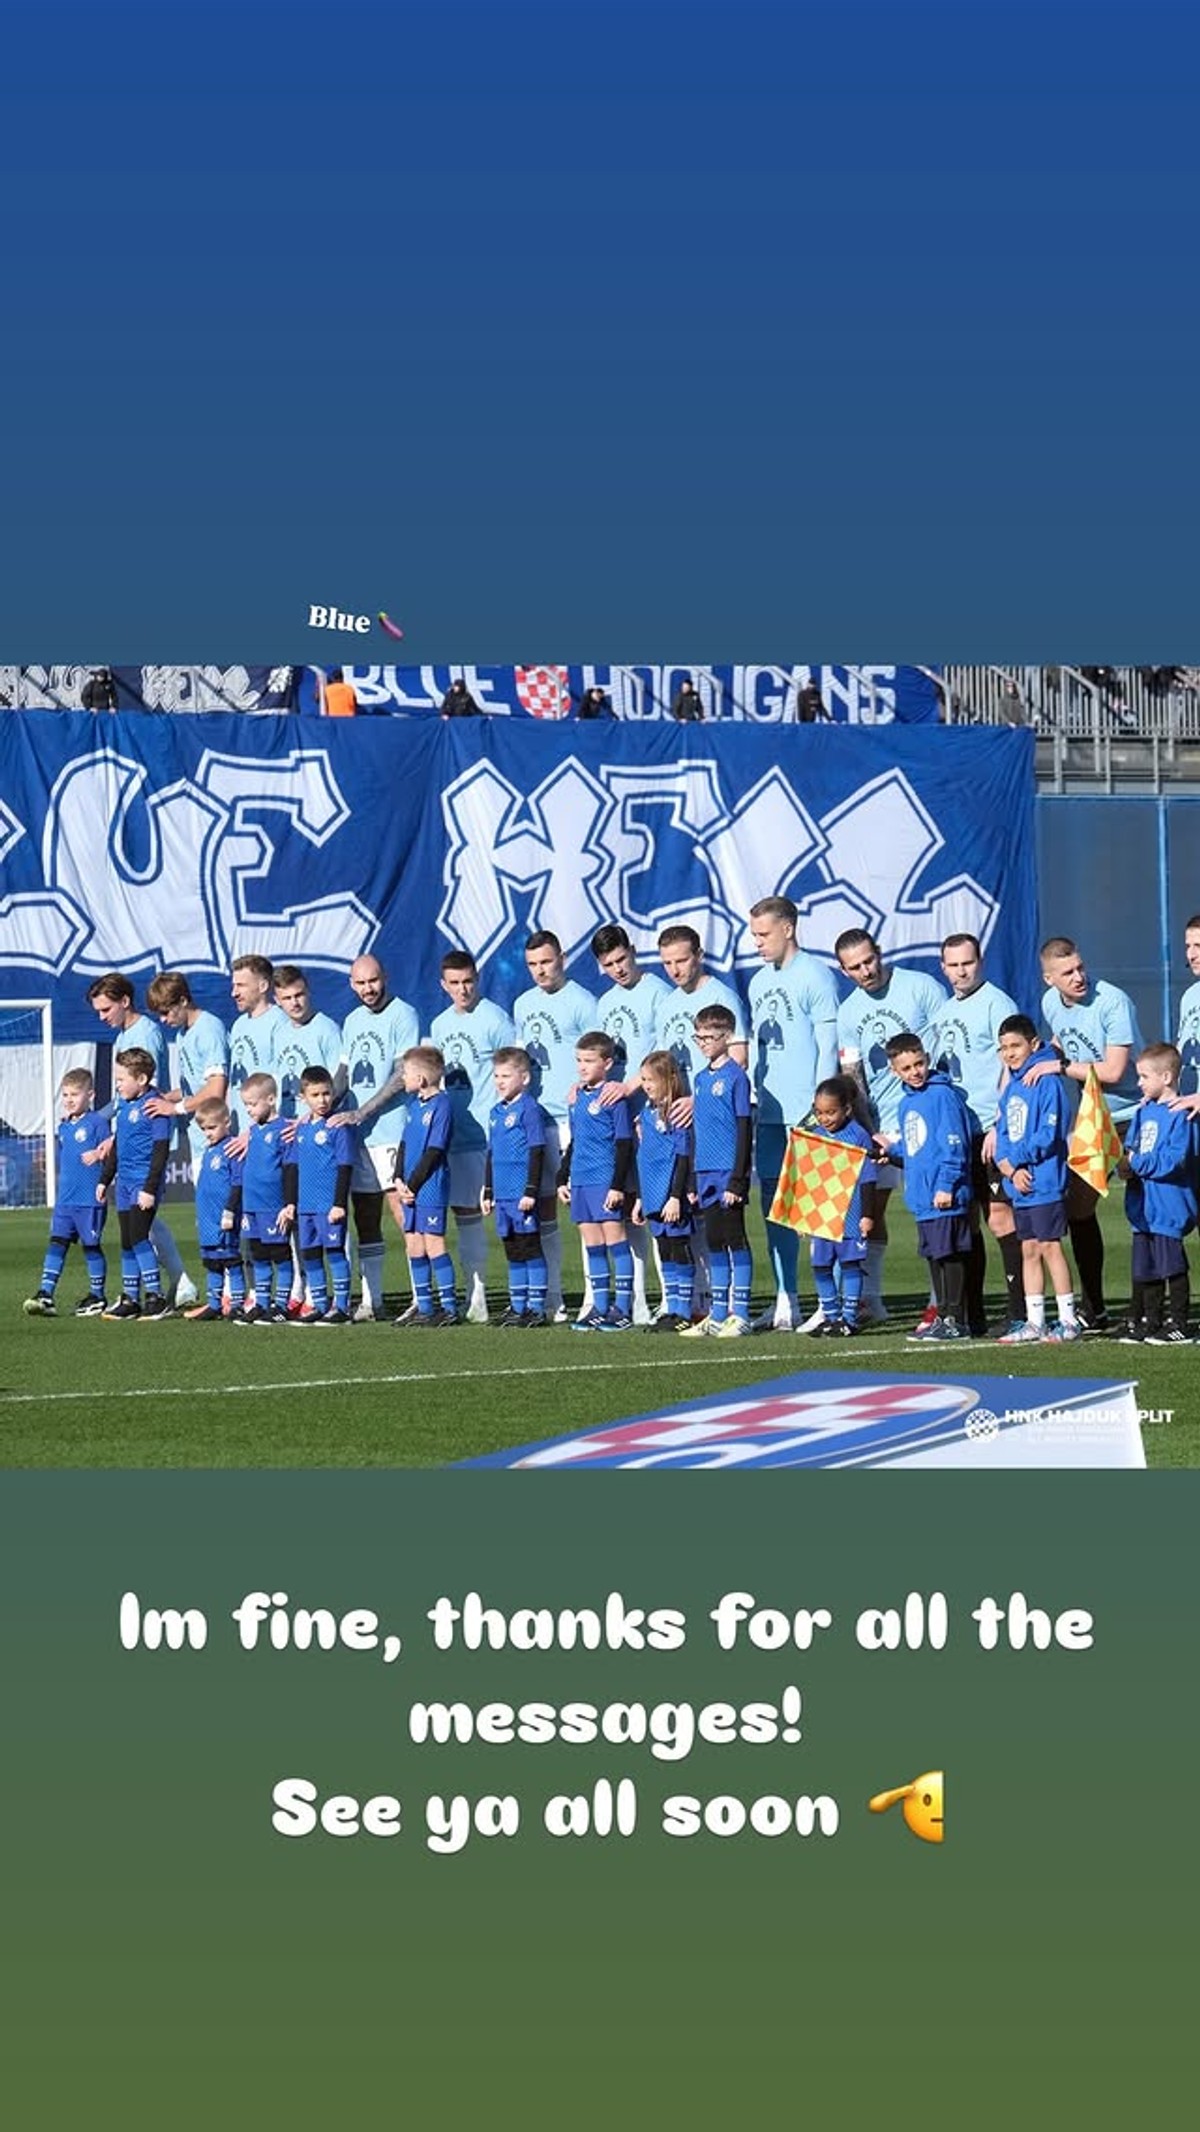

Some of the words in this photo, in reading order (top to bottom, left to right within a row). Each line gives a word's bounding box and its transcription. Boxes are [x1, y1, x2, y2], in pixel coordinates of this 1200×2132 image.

[341, 665, 511, 716] BLUE
[582, 665, 896, 724] HOOLIGANS
[437, 755, 1001, 975] HELL
